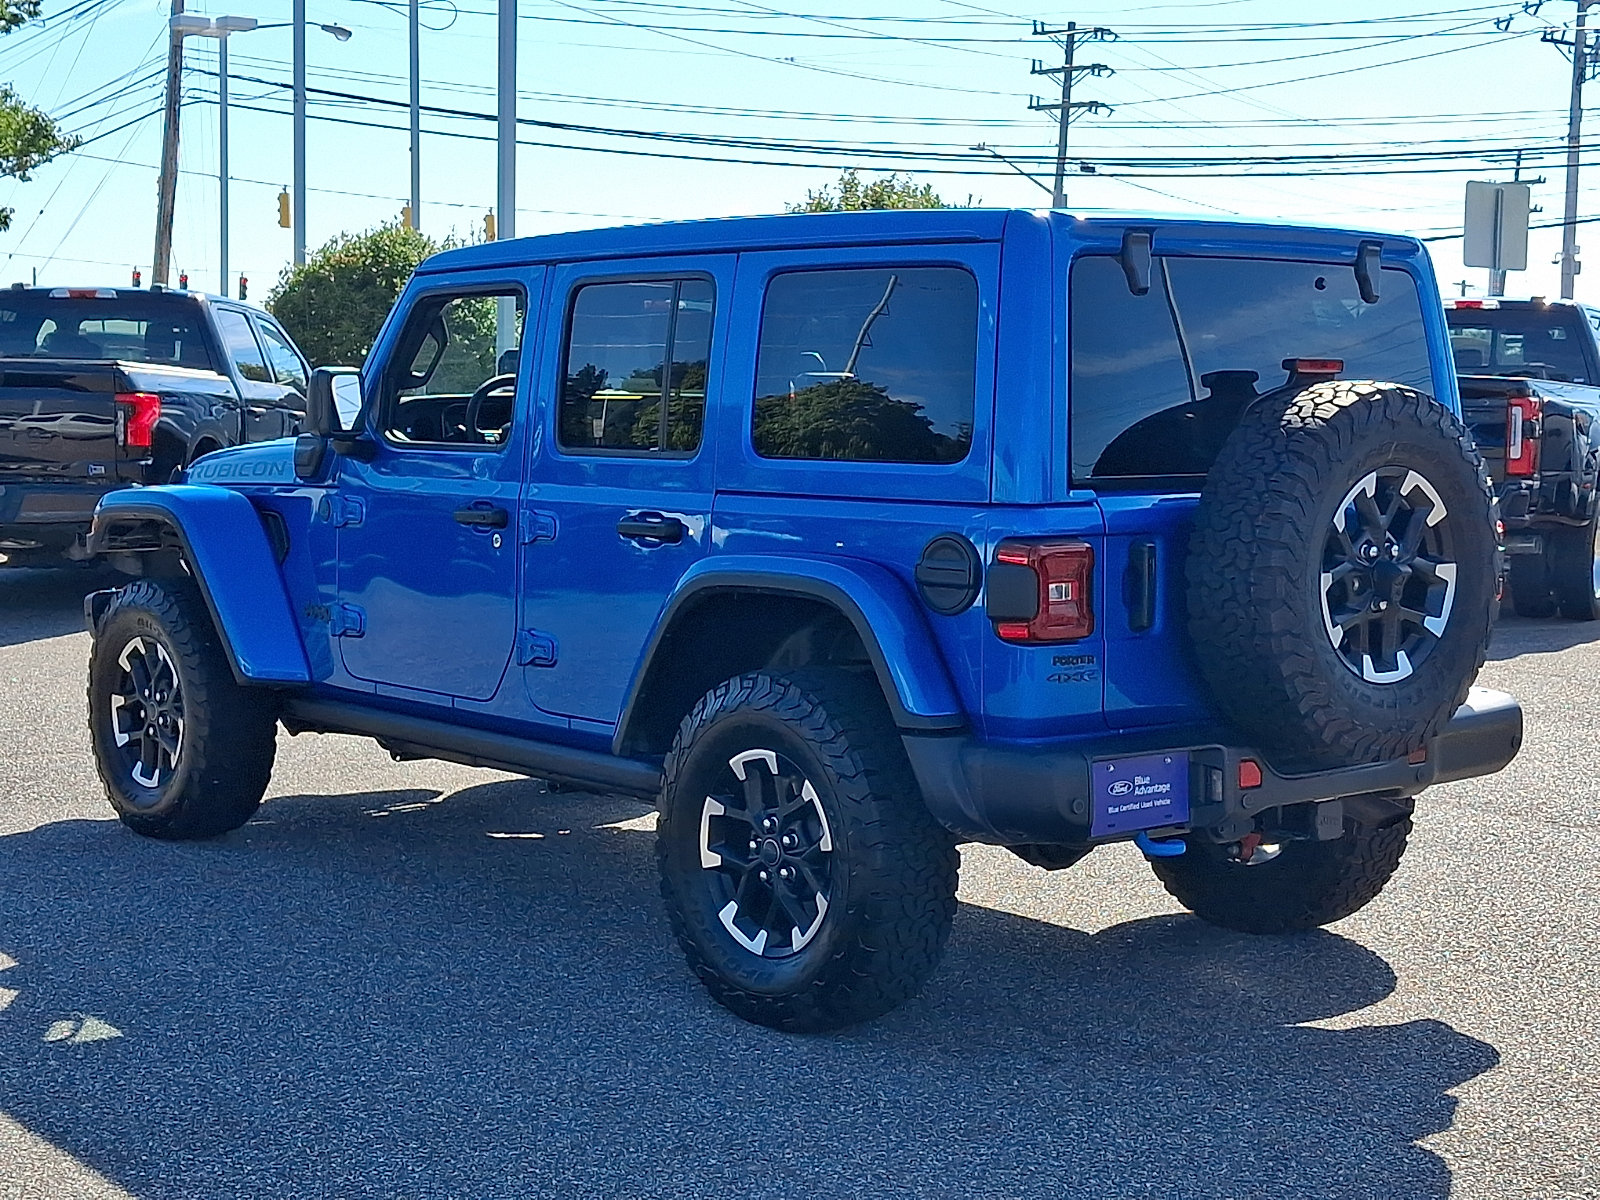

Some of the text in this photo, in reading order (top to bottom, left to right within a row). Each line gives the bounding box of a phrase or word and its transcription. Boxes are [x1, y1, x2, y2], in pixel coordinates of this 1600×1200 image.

[190, 461, 288, 479] RUBICON
[1134, 776, 1151, 785] Blue
[1110, 782, 1131, 795] Ford
[1134, 783, 1171, 796] Advantage
[1108, 806, 1119, 814] Blue
[1120, 802, 1140, 812] Certified
